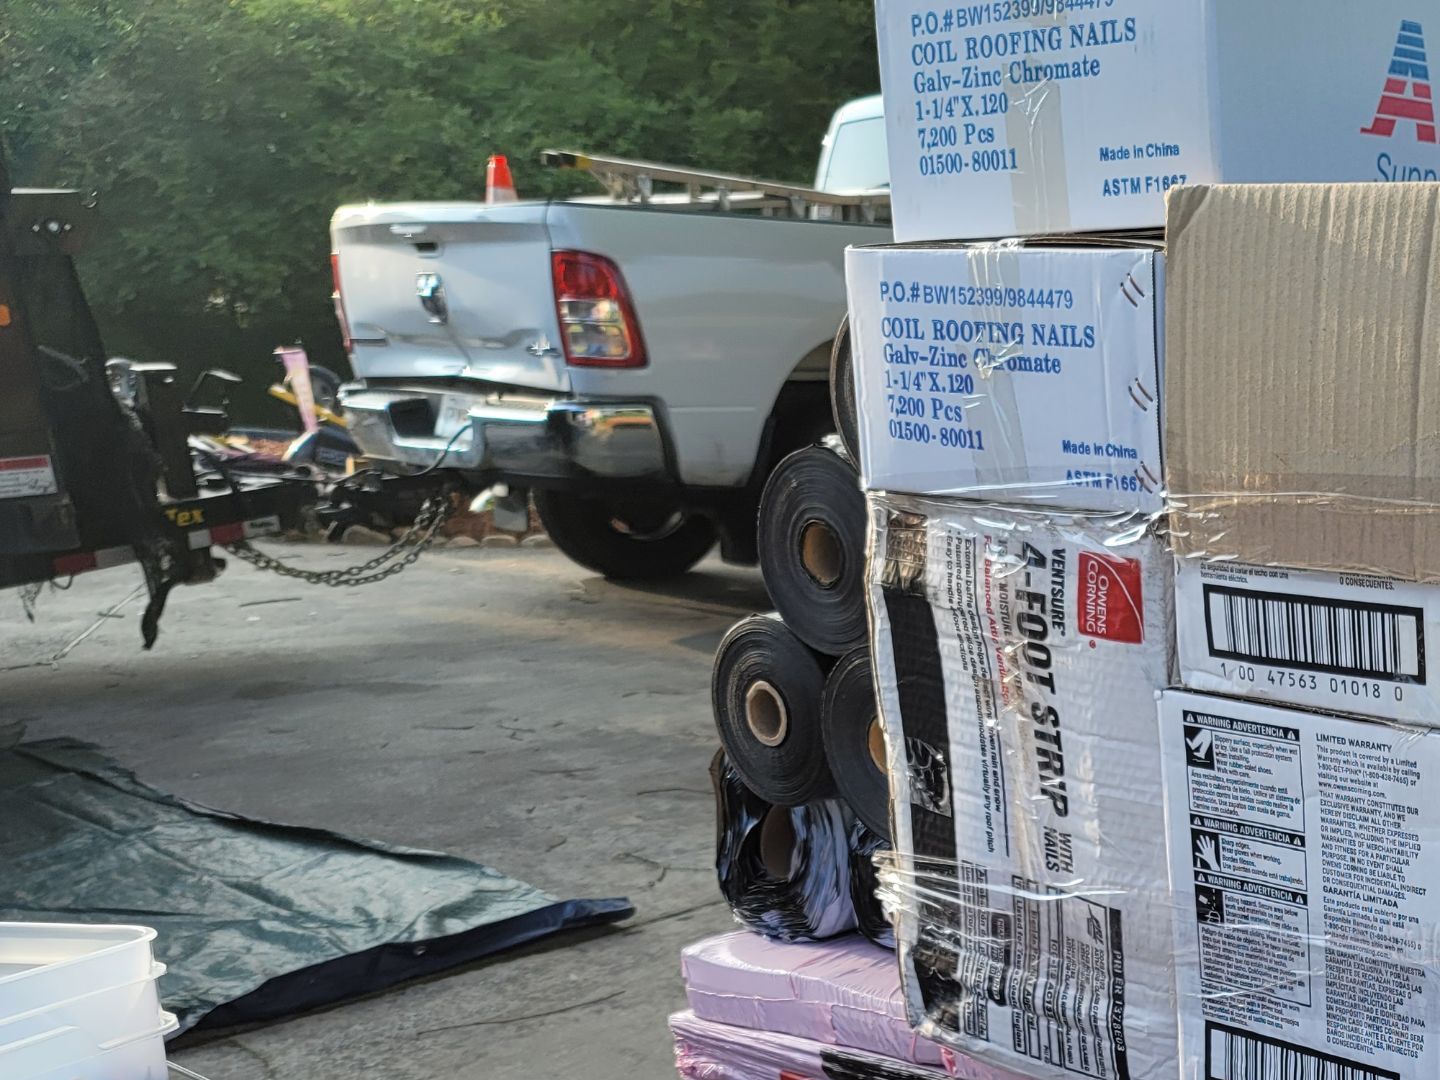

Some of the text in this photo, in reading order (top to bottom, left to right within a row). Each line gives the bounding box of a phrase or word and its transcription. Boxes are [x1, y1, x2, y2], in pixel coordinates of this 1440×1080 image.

[911, 17, 1137, 67] COIL ROOFING NAILS
[913, 55, 1100, 94] Galv-Zinc Chromate
[918, 124, 995, 150] 7,200 Pcs
[1099, 146, 1130, 161] Made
[1146, 142, 1180, 158] China
[1102, 177, 1142, 197] ASTM
[881, 317, 1095, 349] COIL ROOFING NAILS
[883, 343, 967, 369] Galv-Zinc
[887, 394, 962, 422] 7,200 Pcs
[1062, 439, 1091, 456] Made
[1106, 445, 1138, 460] China
[1086, 560, 1098, 633] CORNING
[1096, 575, 1108, 635] OWENS
[1015, 541, 1068, 818] 4-FOOT STRIP
[1239, 665, 1256, 683] 00
[1267, 670, 1318, 690] 47563
[1329, 678, 1381, 699] 01018
[1196, 715, 1285, 739] WARNING ADVERTENCIA
[1316, 732, 1392, 753] LIMITED WARRANTY
[1203, 818, 1291, 844] WARNING ADVERTENCIA
[1043, 825, 1060, 873] NAILS
[1059, 831, 1074, 874] WITH
[1207, 875, 1293, 902] WARNING ADVERTENCIA
[1362, 893, 1399, 910] LIMITADA
